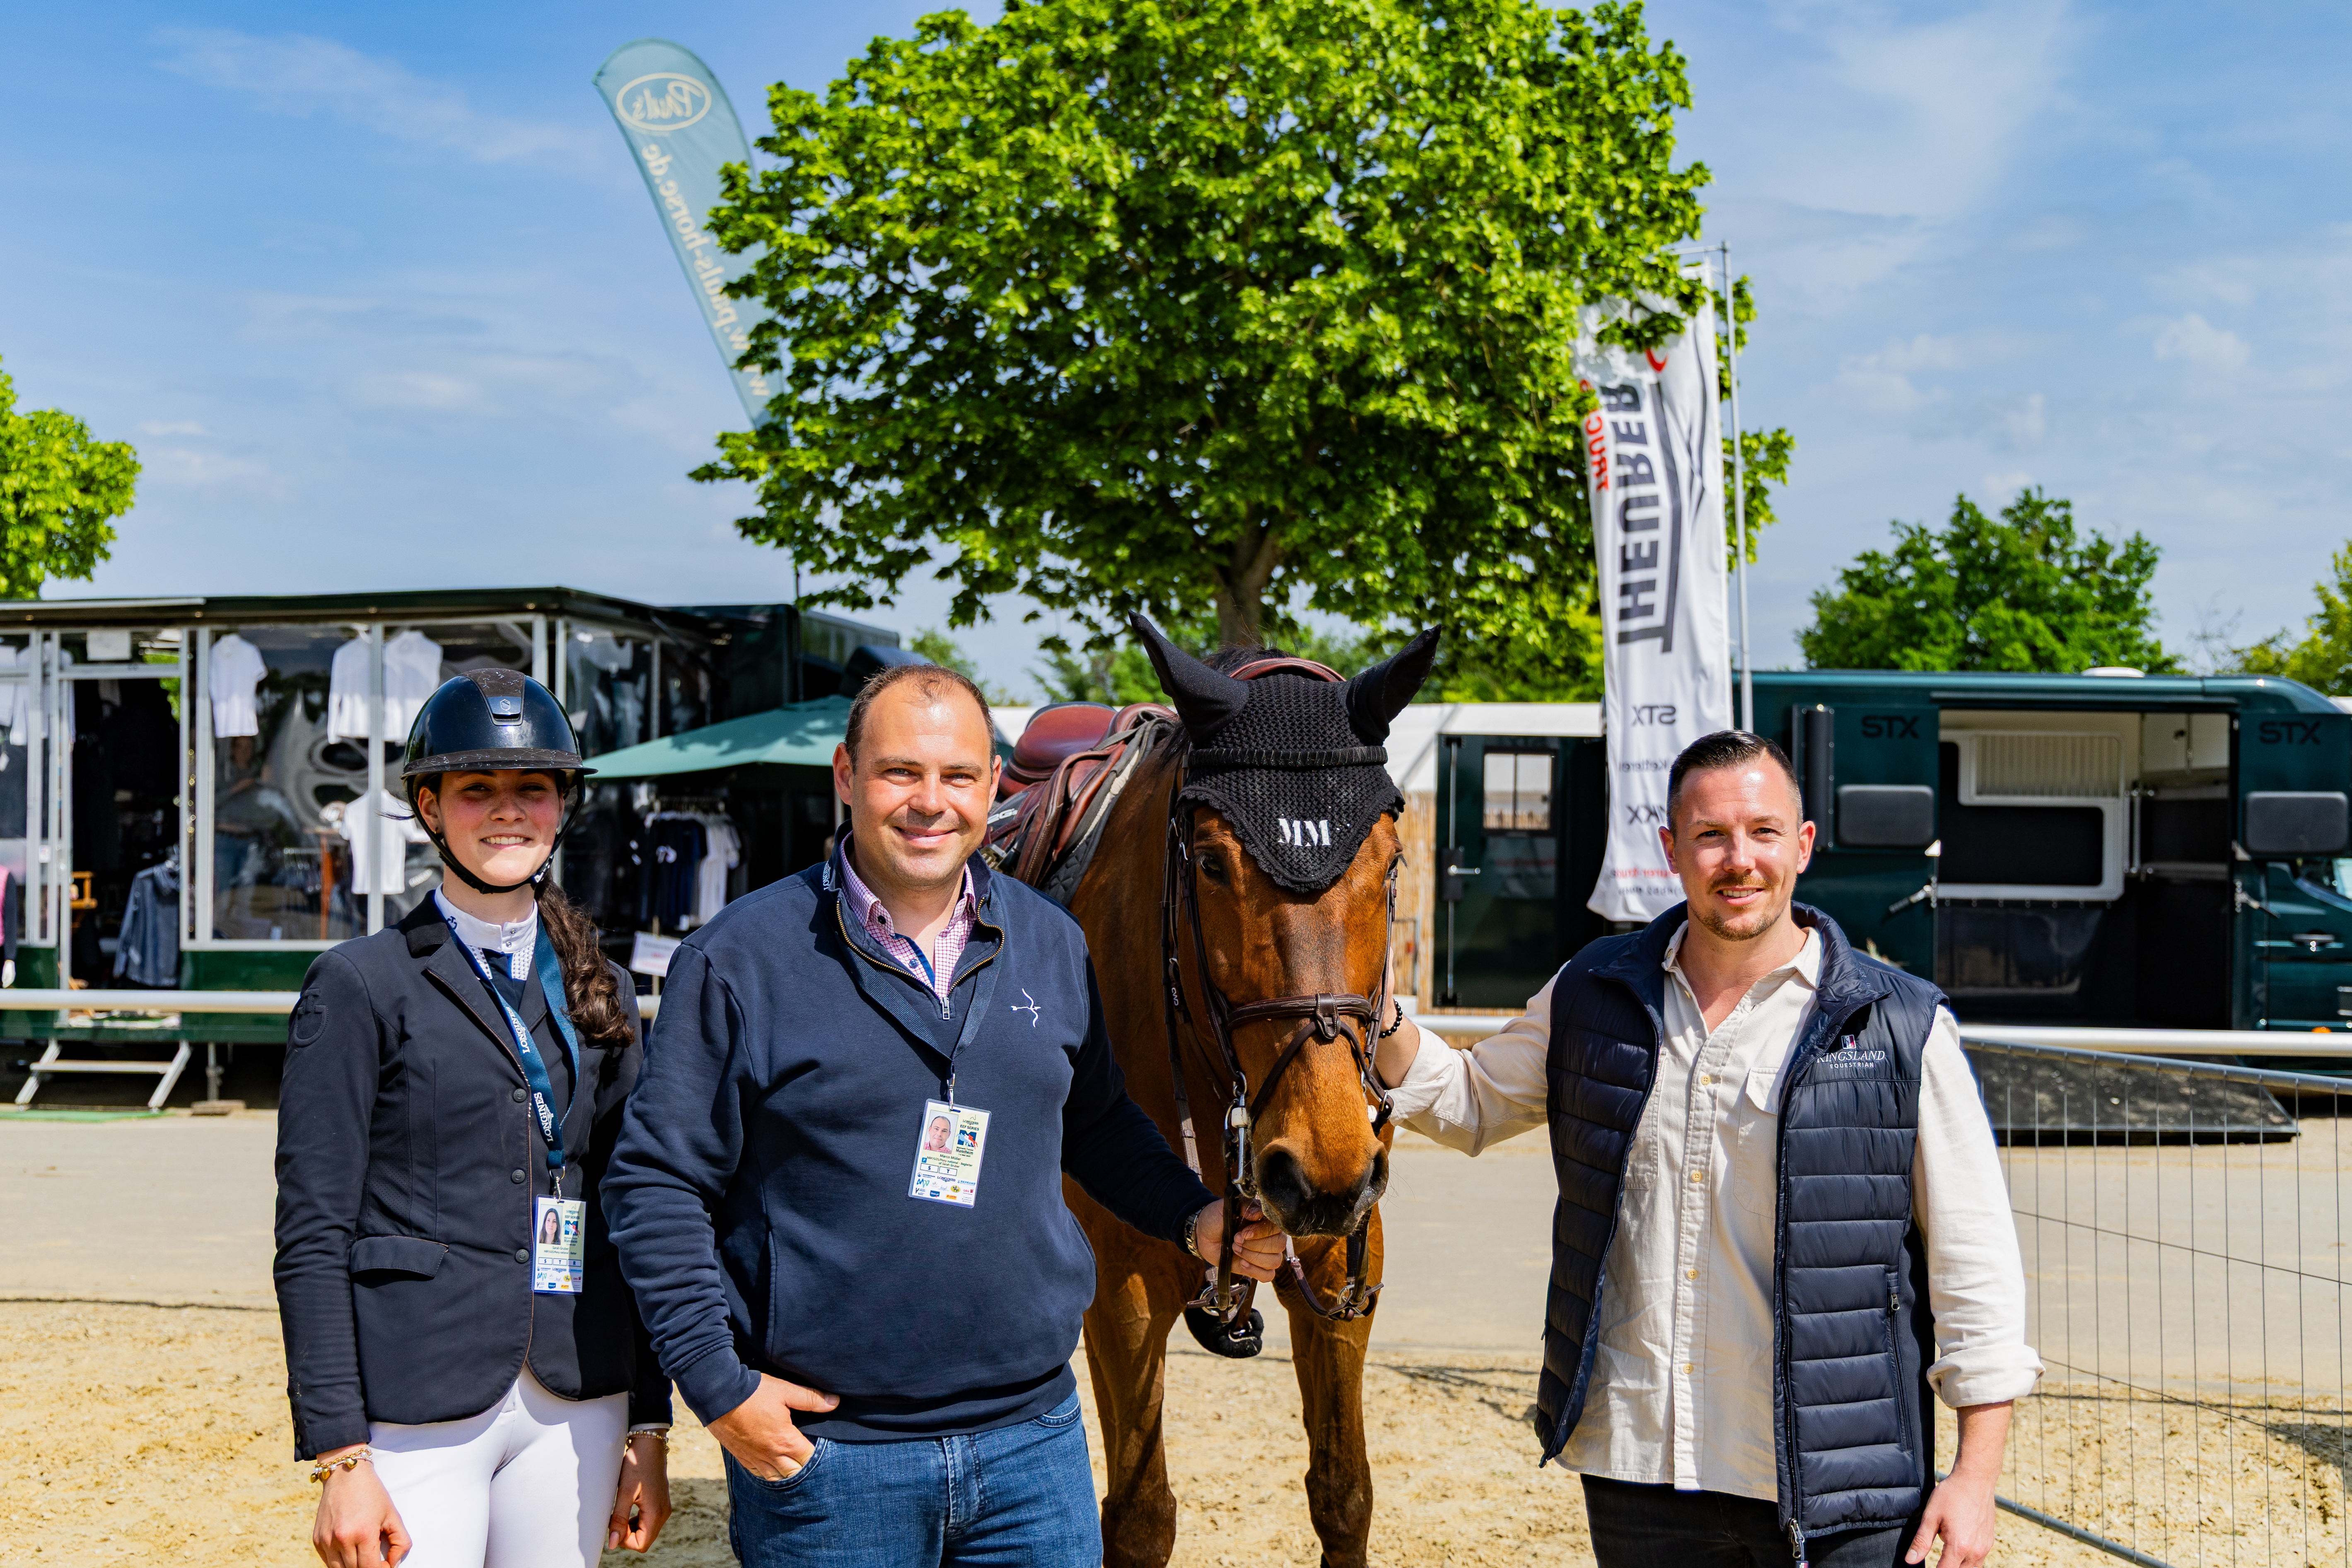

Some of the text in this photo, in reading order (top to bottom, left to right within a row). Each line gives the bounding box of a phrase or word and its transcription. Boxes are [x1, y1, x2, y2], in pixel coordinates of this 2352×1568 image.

[1861, 715, 1920, 739] STX
[2259, 720, 2321, 744] STX
[505, 1006, 531, 1053] LONGINES
[534, 1092, 554, 1143] LONGINES
